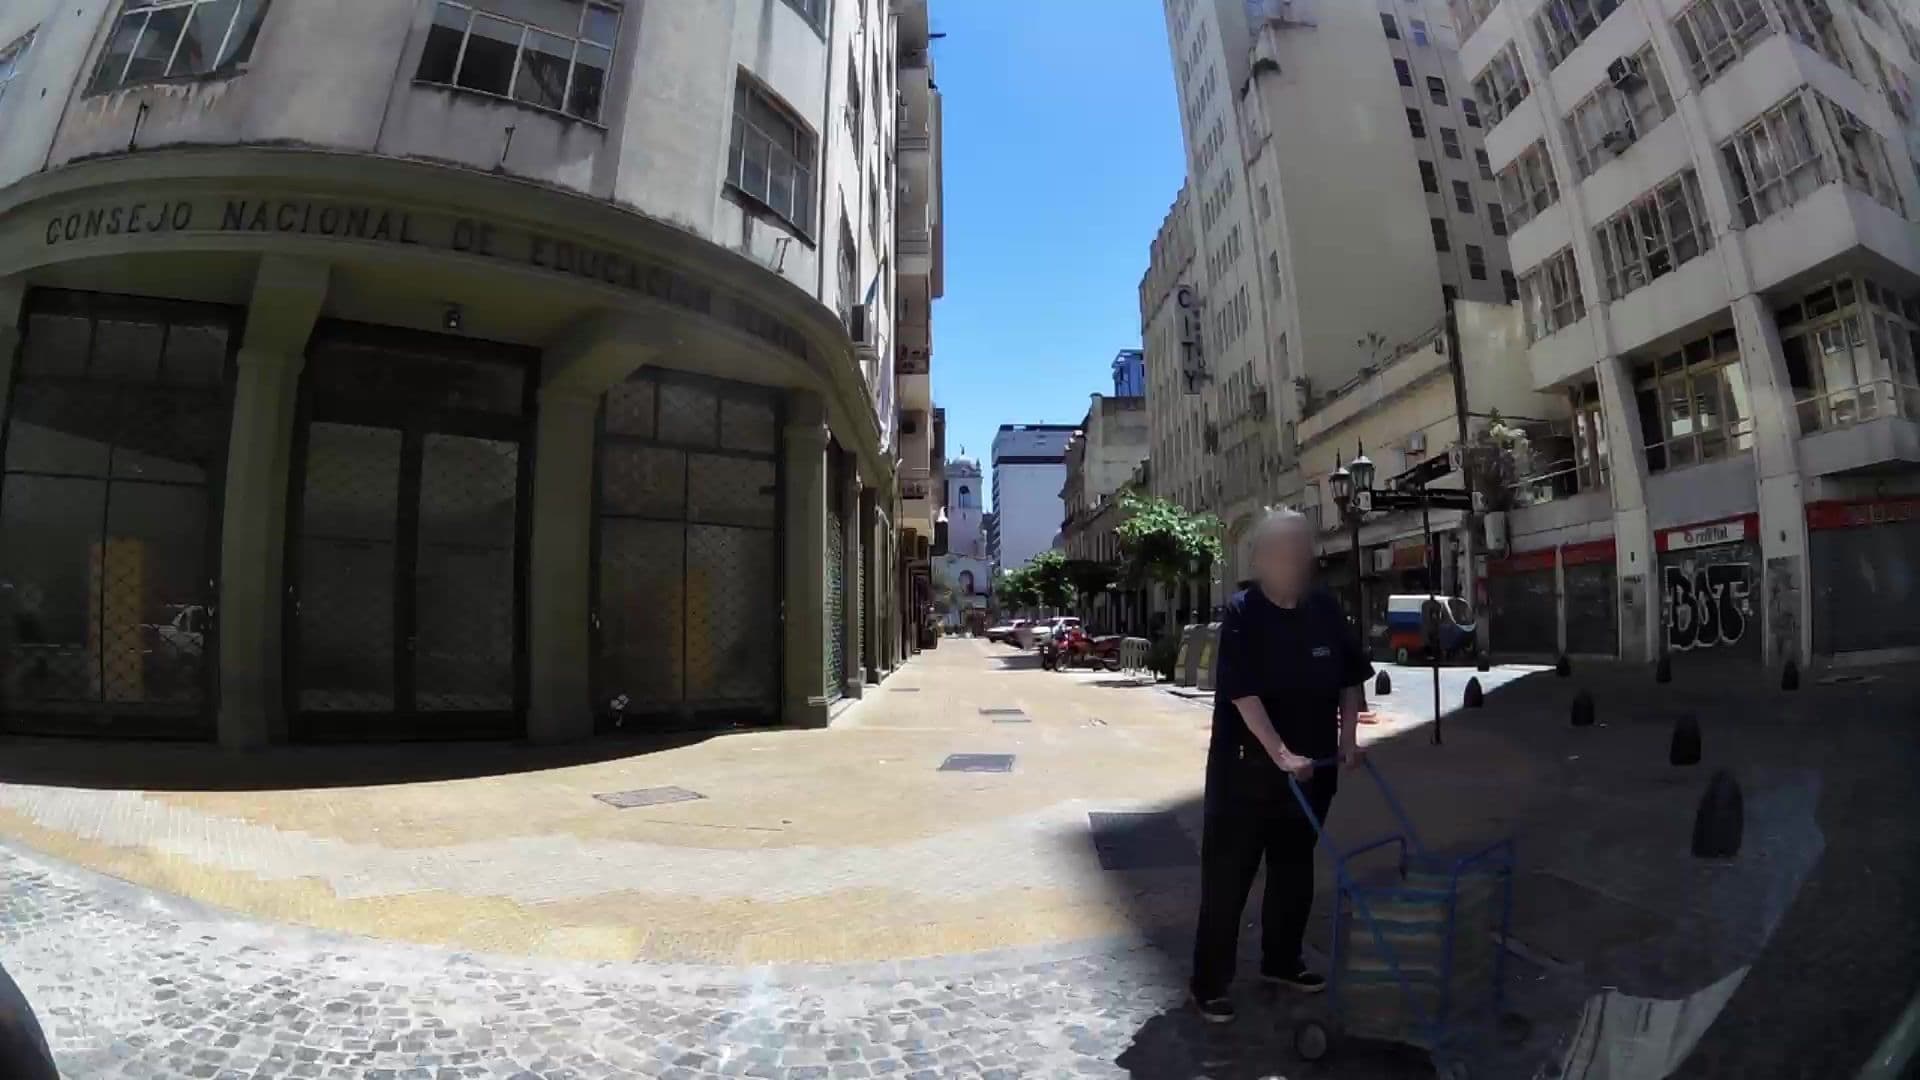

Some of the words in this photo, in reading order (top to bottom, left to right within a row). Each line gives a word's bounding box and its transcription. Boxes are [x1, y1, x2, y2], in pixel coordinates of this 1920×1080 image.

[46, 201, 192, 245] CONSEJO
[221, 201, 418, 244] NACIONAL
[452, 217, 499, 256] DE
[1177, 289, 1195, 392] CITY
